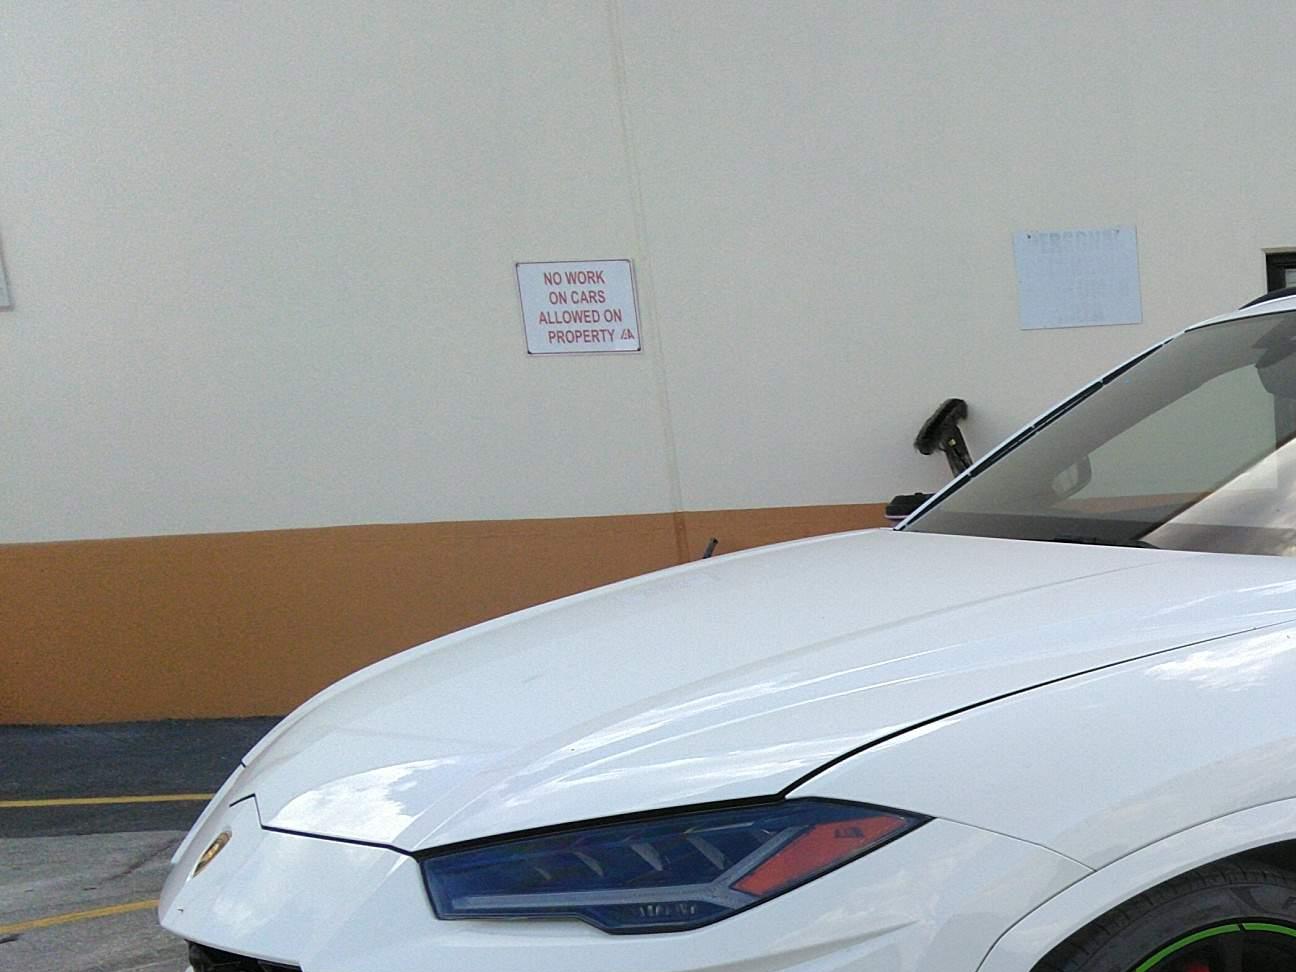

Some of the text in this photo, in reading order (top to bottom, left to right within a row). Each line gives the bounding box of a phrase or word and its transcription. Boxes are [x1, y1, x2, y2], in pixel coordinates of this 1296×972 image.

[543, 270, 606, 286] NO WORK
[549, 290, 606, 305] ON CARS
[539, 309, 623, 325] ALLOWED ON
[548, 329, 615, 344] PROPERTY
